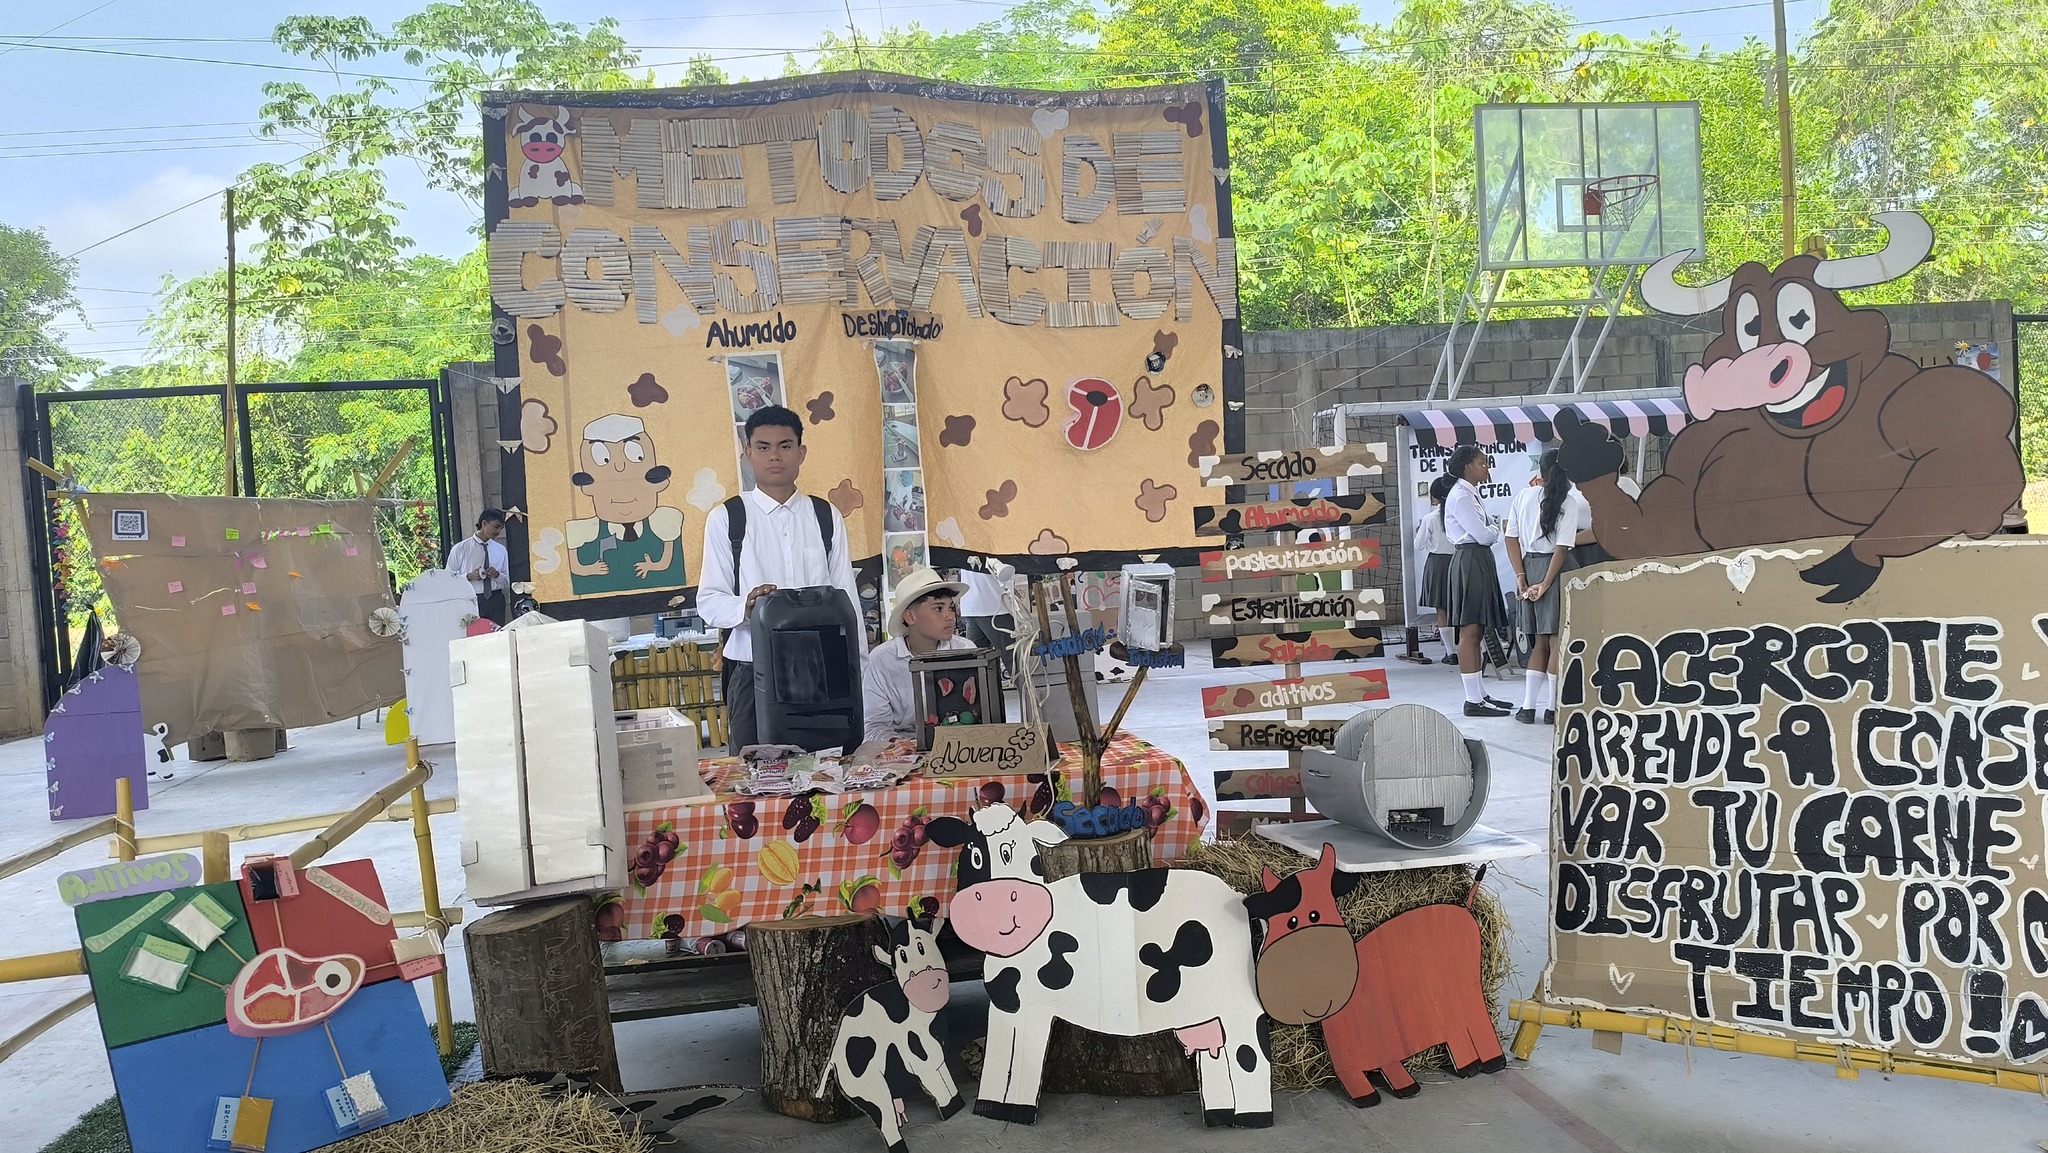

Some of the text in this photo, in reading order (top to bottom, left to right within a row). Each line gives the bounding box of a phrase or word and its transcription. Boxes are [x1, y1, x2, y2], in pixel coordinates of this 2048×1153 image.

[580, 107, 1185, 223] METODOS DE
[489, 213, 1237, 328] CONSERVACIÓN
[706, 312, 797, 348] Ahumado
[1240, 450, 1317, 481] Secado
[1420, 459, 1437, 473] DE
[1244, 500, 1341, 529] Ahumado
[1230, 595, 1355, 622] Esterilización
[1260, 681, 1336, 708] aditivos
[1556, 708, 1770, 786] APRENDE
[1766, 703, 1840, 788] A
[1560, 784, 1669, 865] VAR
[1690, 788, 1781, 871] TU
[1790, 788, 2026, 882] CARNE
[1554, 862, 1864, 960] DISFRUTAR
[1897, 879, 2013, 970] POR
